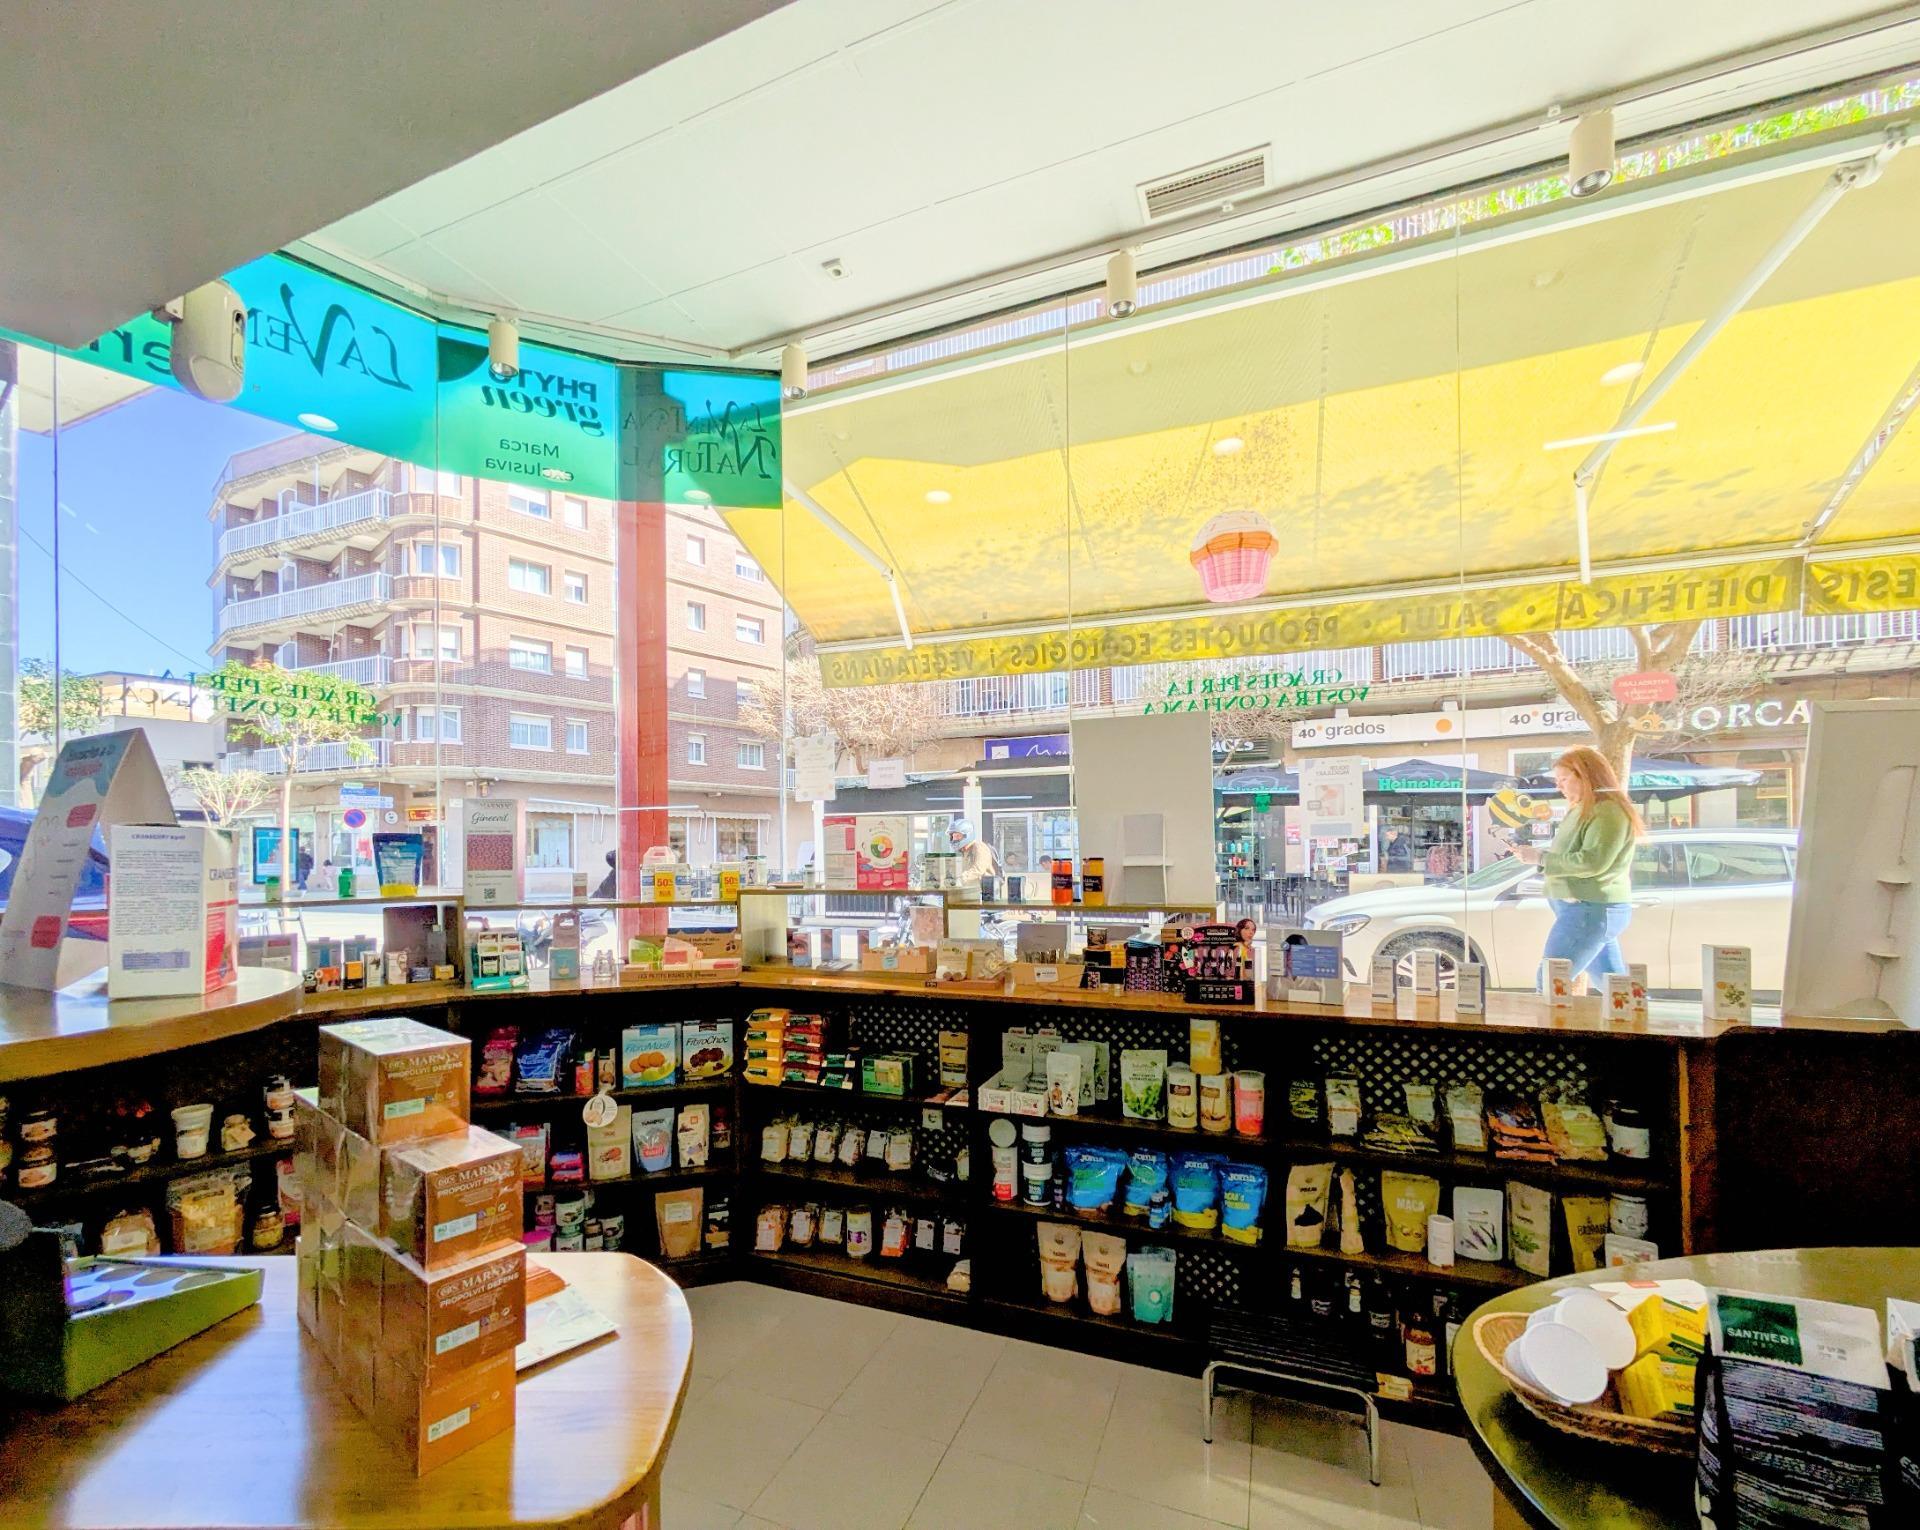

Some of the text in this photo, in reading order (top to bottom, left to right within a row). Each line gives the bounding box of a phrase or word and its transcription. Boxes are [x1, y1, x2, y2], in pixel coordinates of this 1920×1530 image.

[1325, 721, 1386, 741] grados
[1378, 778, 1462, 791] Heineken
[459, 1159, 511, 1181] MARNYS
[461, 1259, 519, 1288] MARNYS
